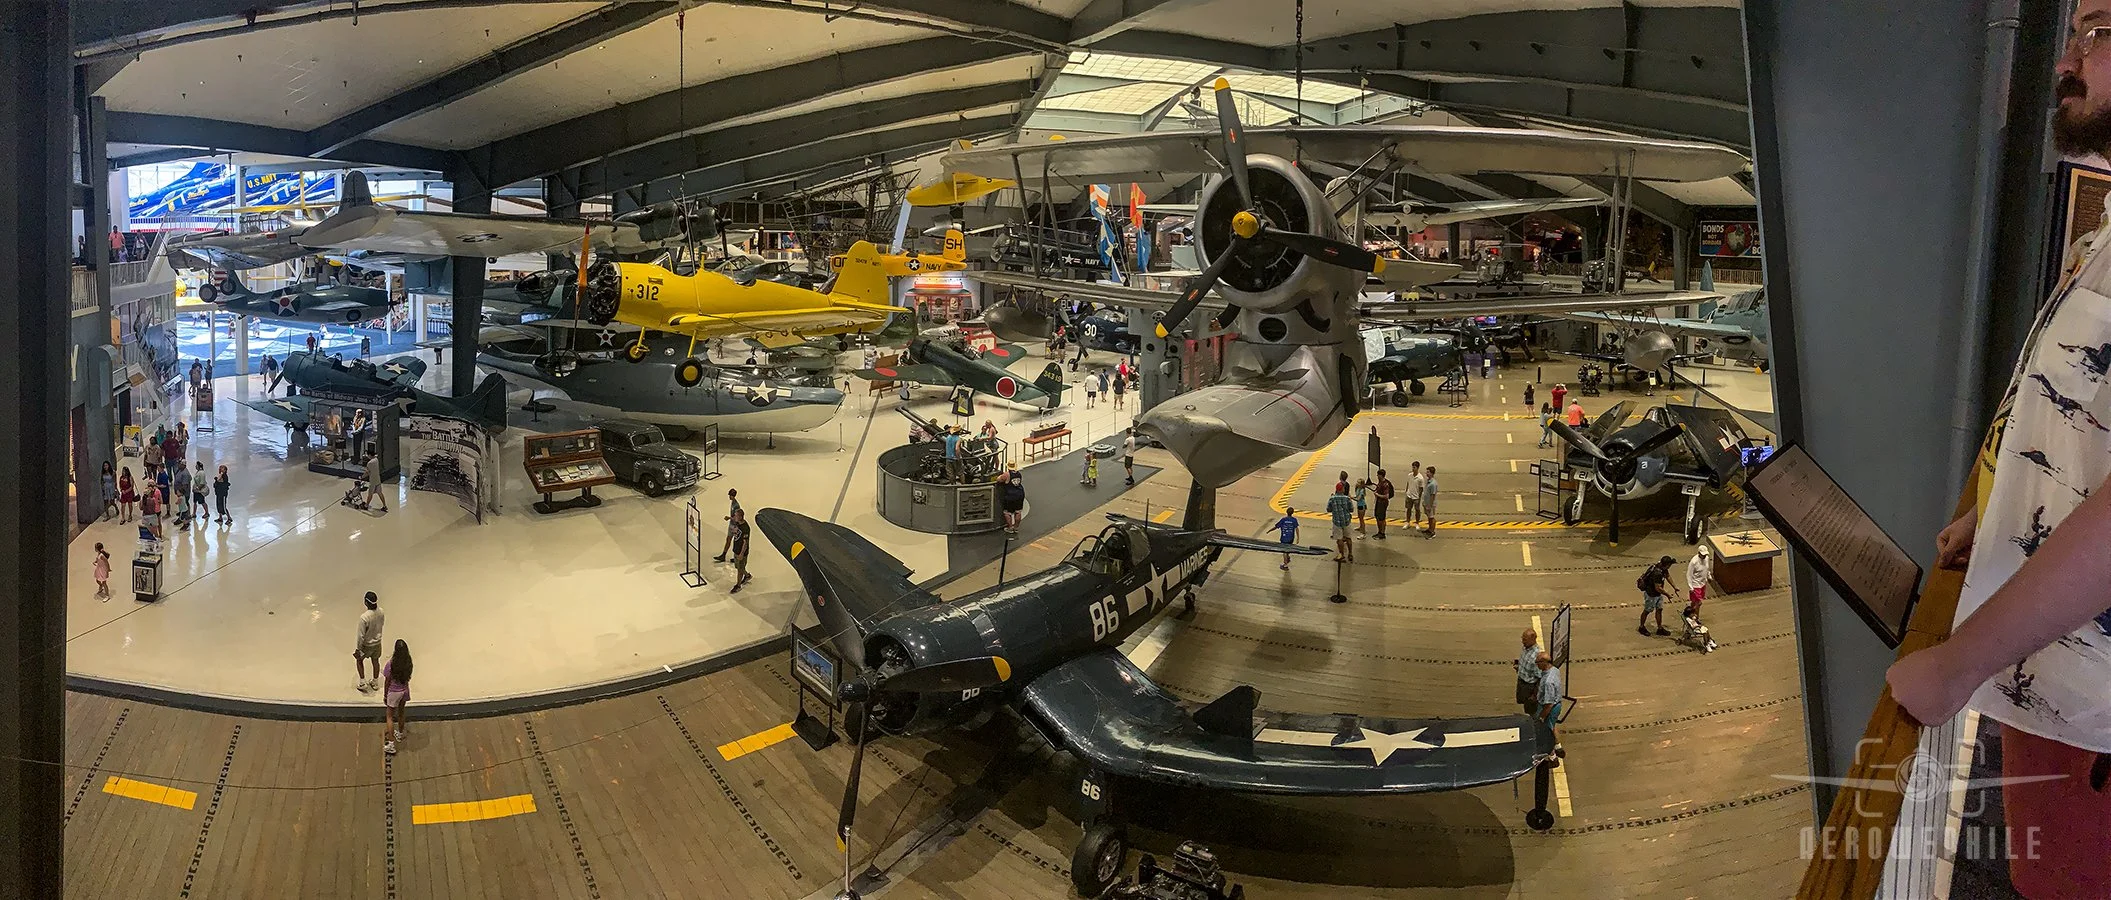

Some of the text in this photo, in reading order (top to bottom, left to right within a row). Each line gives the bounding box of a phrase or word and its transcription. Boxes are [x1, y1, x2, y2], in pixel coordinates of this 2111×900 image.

[261, 173, 277, 185] NAVY
[1702, 225, 1725, 233] BONDS
[945, 238, 962, 250] SH
[925, 263, 942, 271] NAVY
[1084, 258, 1100, 266] NAVY
[636, 283, 659, 301] 312
[1084, 323, 1097, 337] 30
[1579, 471, 1589, 479] 21
[1089, 594, 1120, 642] 86
[1081, 779, 1101, 801] 86
